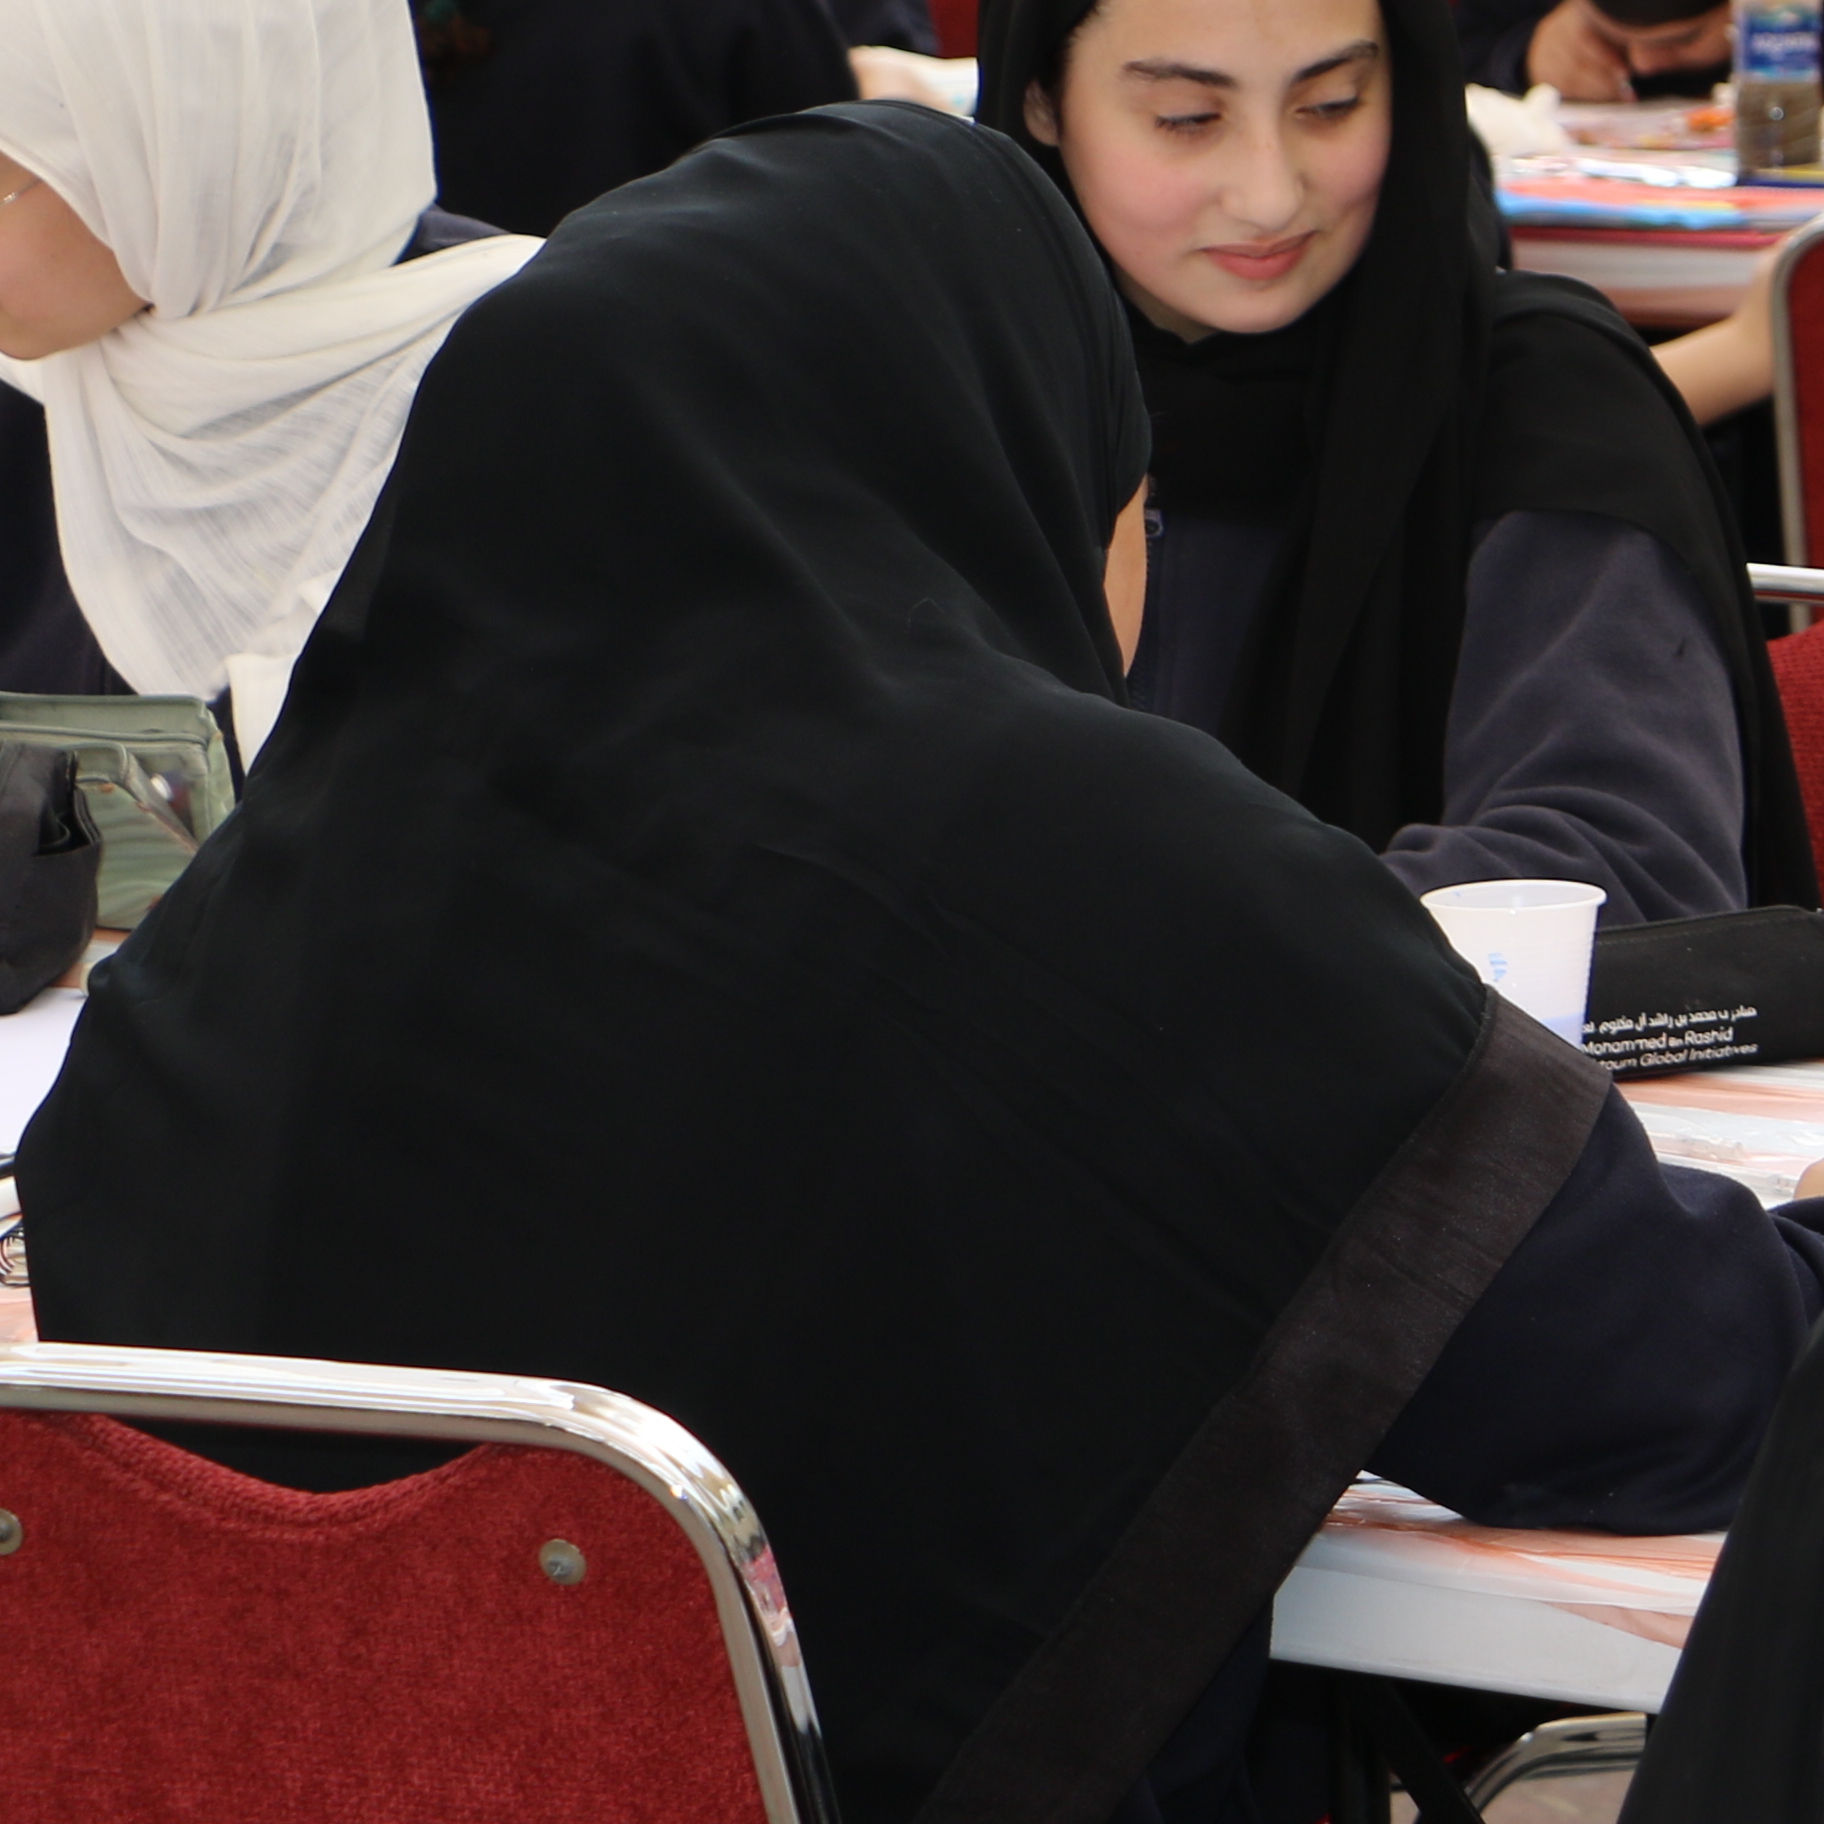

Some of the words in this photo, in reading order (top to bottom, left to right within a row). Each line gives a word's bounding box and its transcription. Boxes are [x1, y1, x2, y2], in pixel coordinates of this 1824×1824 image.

[1582, 1032, 1668, 1056] Mohammed
[1684, 1026, 1734, 1046] Rashid
[1640, 1048, 1688, 1068] Global
[1688, 1042, 1759, 1062] Initiatives
